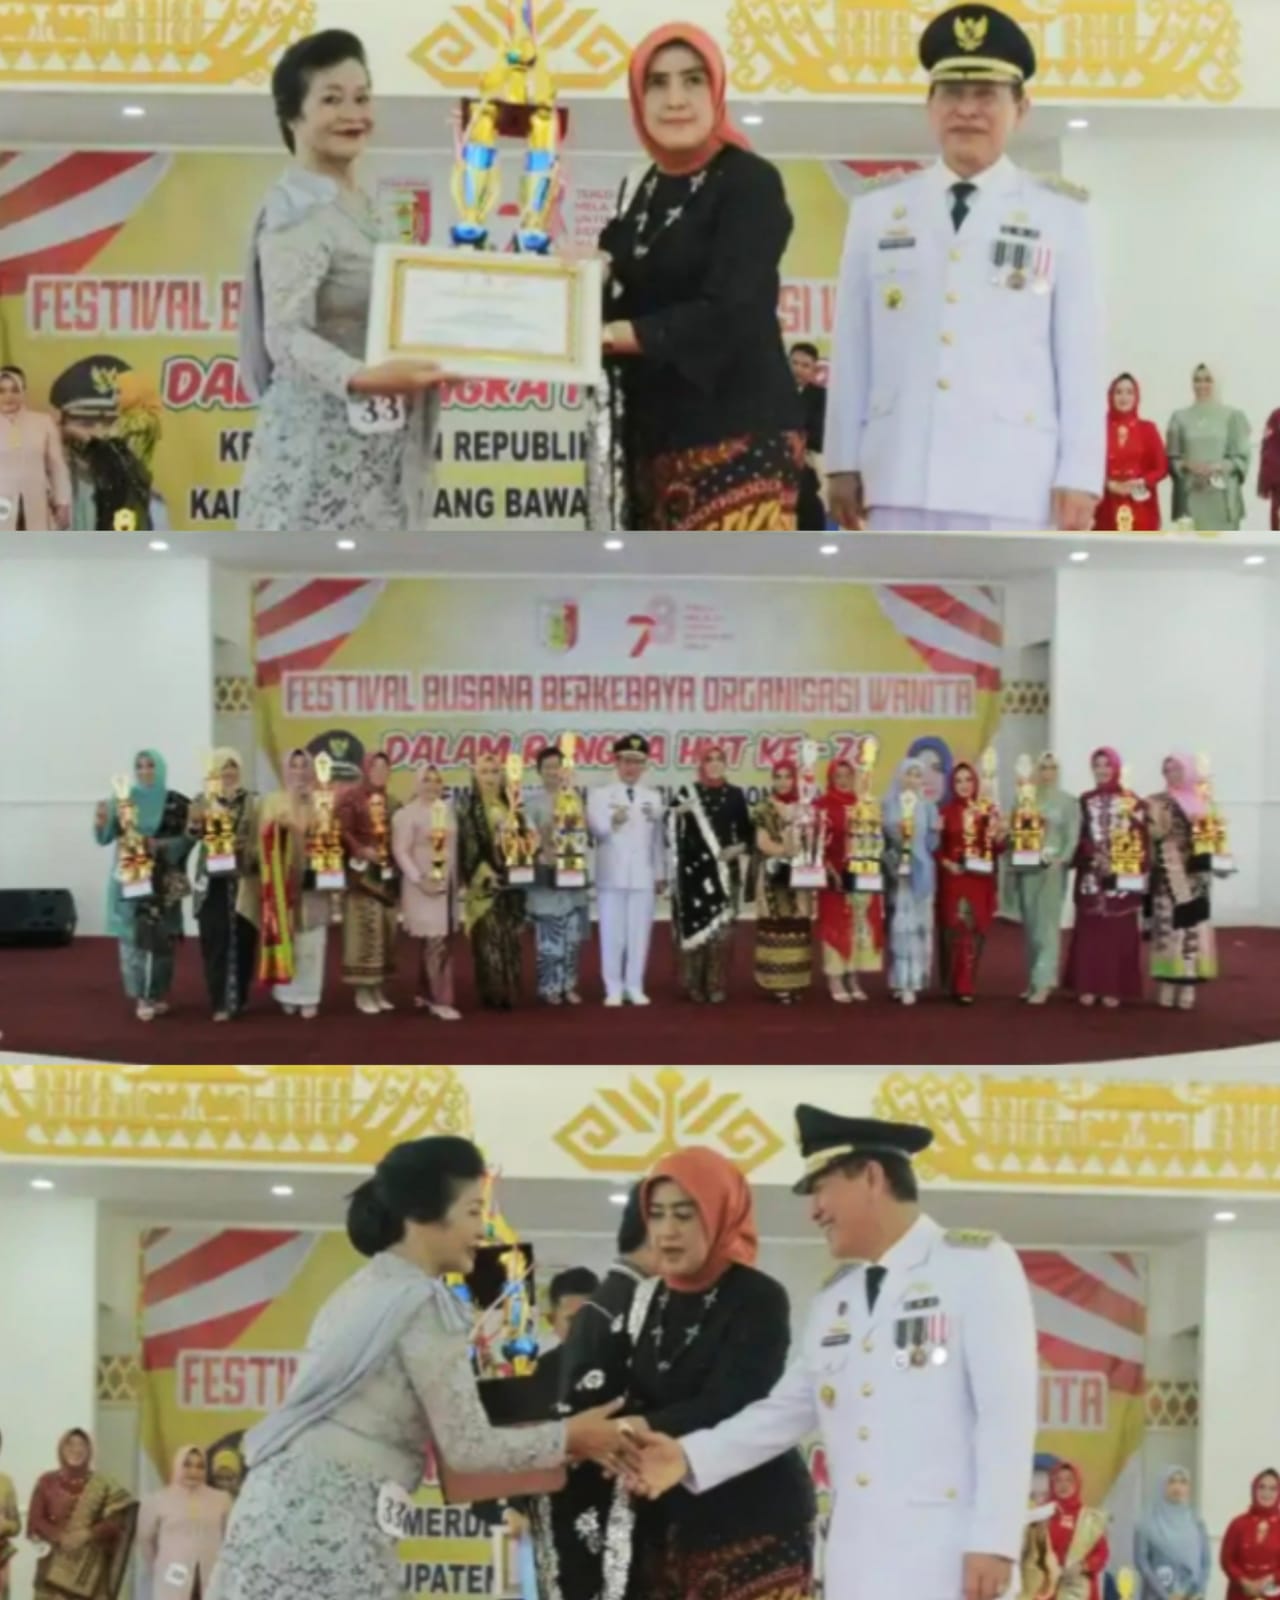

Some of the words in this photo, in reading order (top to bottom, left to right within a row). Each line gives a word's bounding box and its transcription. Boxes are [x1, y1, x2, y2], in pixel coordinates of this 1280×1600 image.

[33, 280, 211, 332] FESTIVAL
[361, 395, 400, 424] 33
[433, 488, 494, 518] ANG
[505, 488, 588, 518] BAWA
[286, 674, 415, 711] FESTIVAL
[423, 674, 533, 712] BUSANA
[541, 674, 696, 713] BERKEBAYA
[703, 676, 861, 713] ORGANISASI
[869, 677, 973, 715] WANITA
[384, 733, 512, 766] DALAM
[523, 733, 665, 766] RNGA
[184, 1355, 297, 1406] FESTI
[1042, 1376, 1103, 1425] ITA
